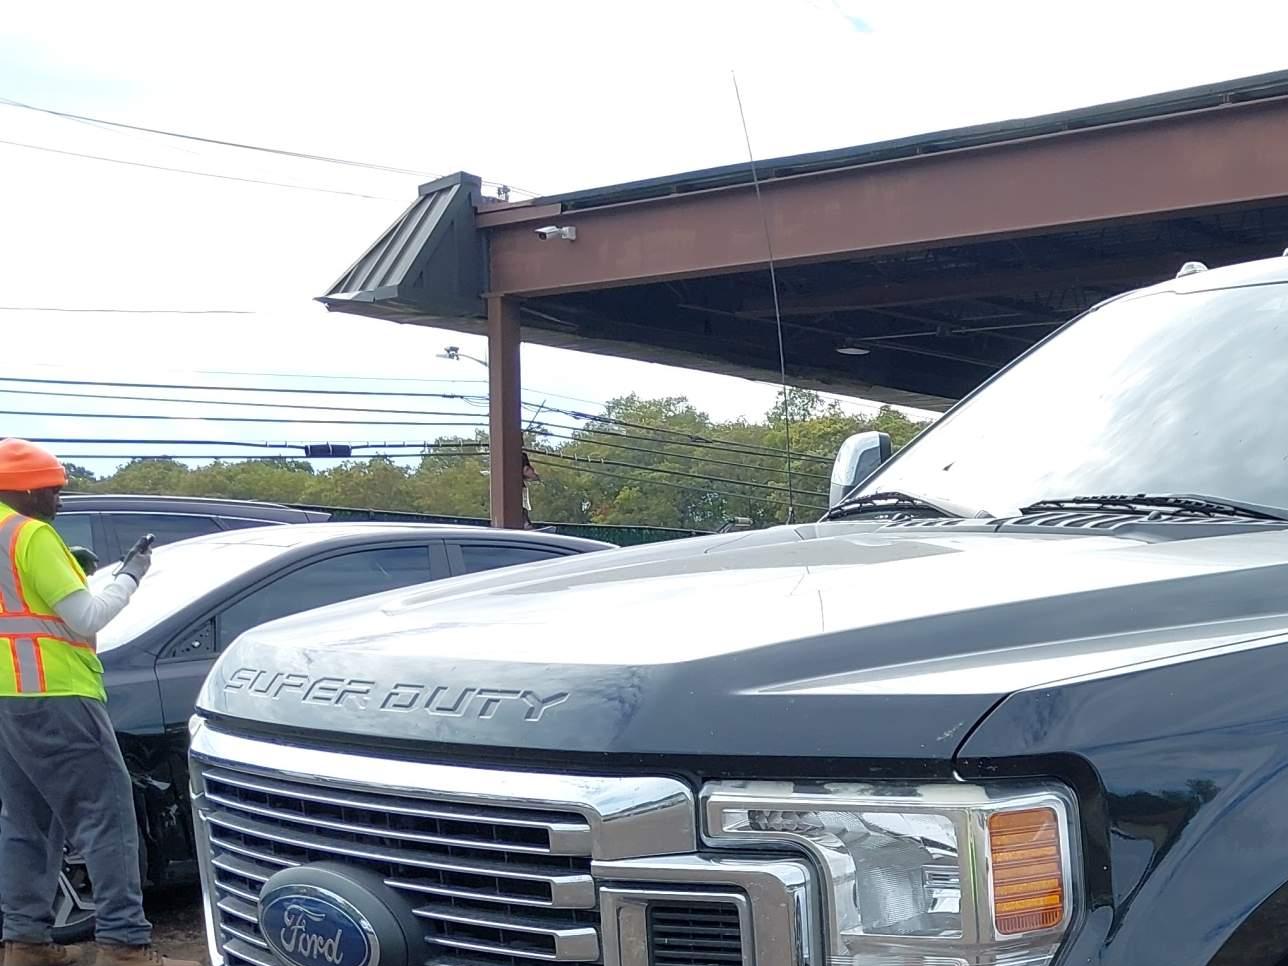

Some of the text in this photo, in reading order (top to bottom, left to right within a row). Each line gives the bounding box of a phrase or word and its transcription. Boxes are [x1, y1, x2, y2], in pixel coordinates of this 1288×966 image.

[224, 667, 570, 723] SUPER DUTY
[280, 903, 344, 965] Ford
